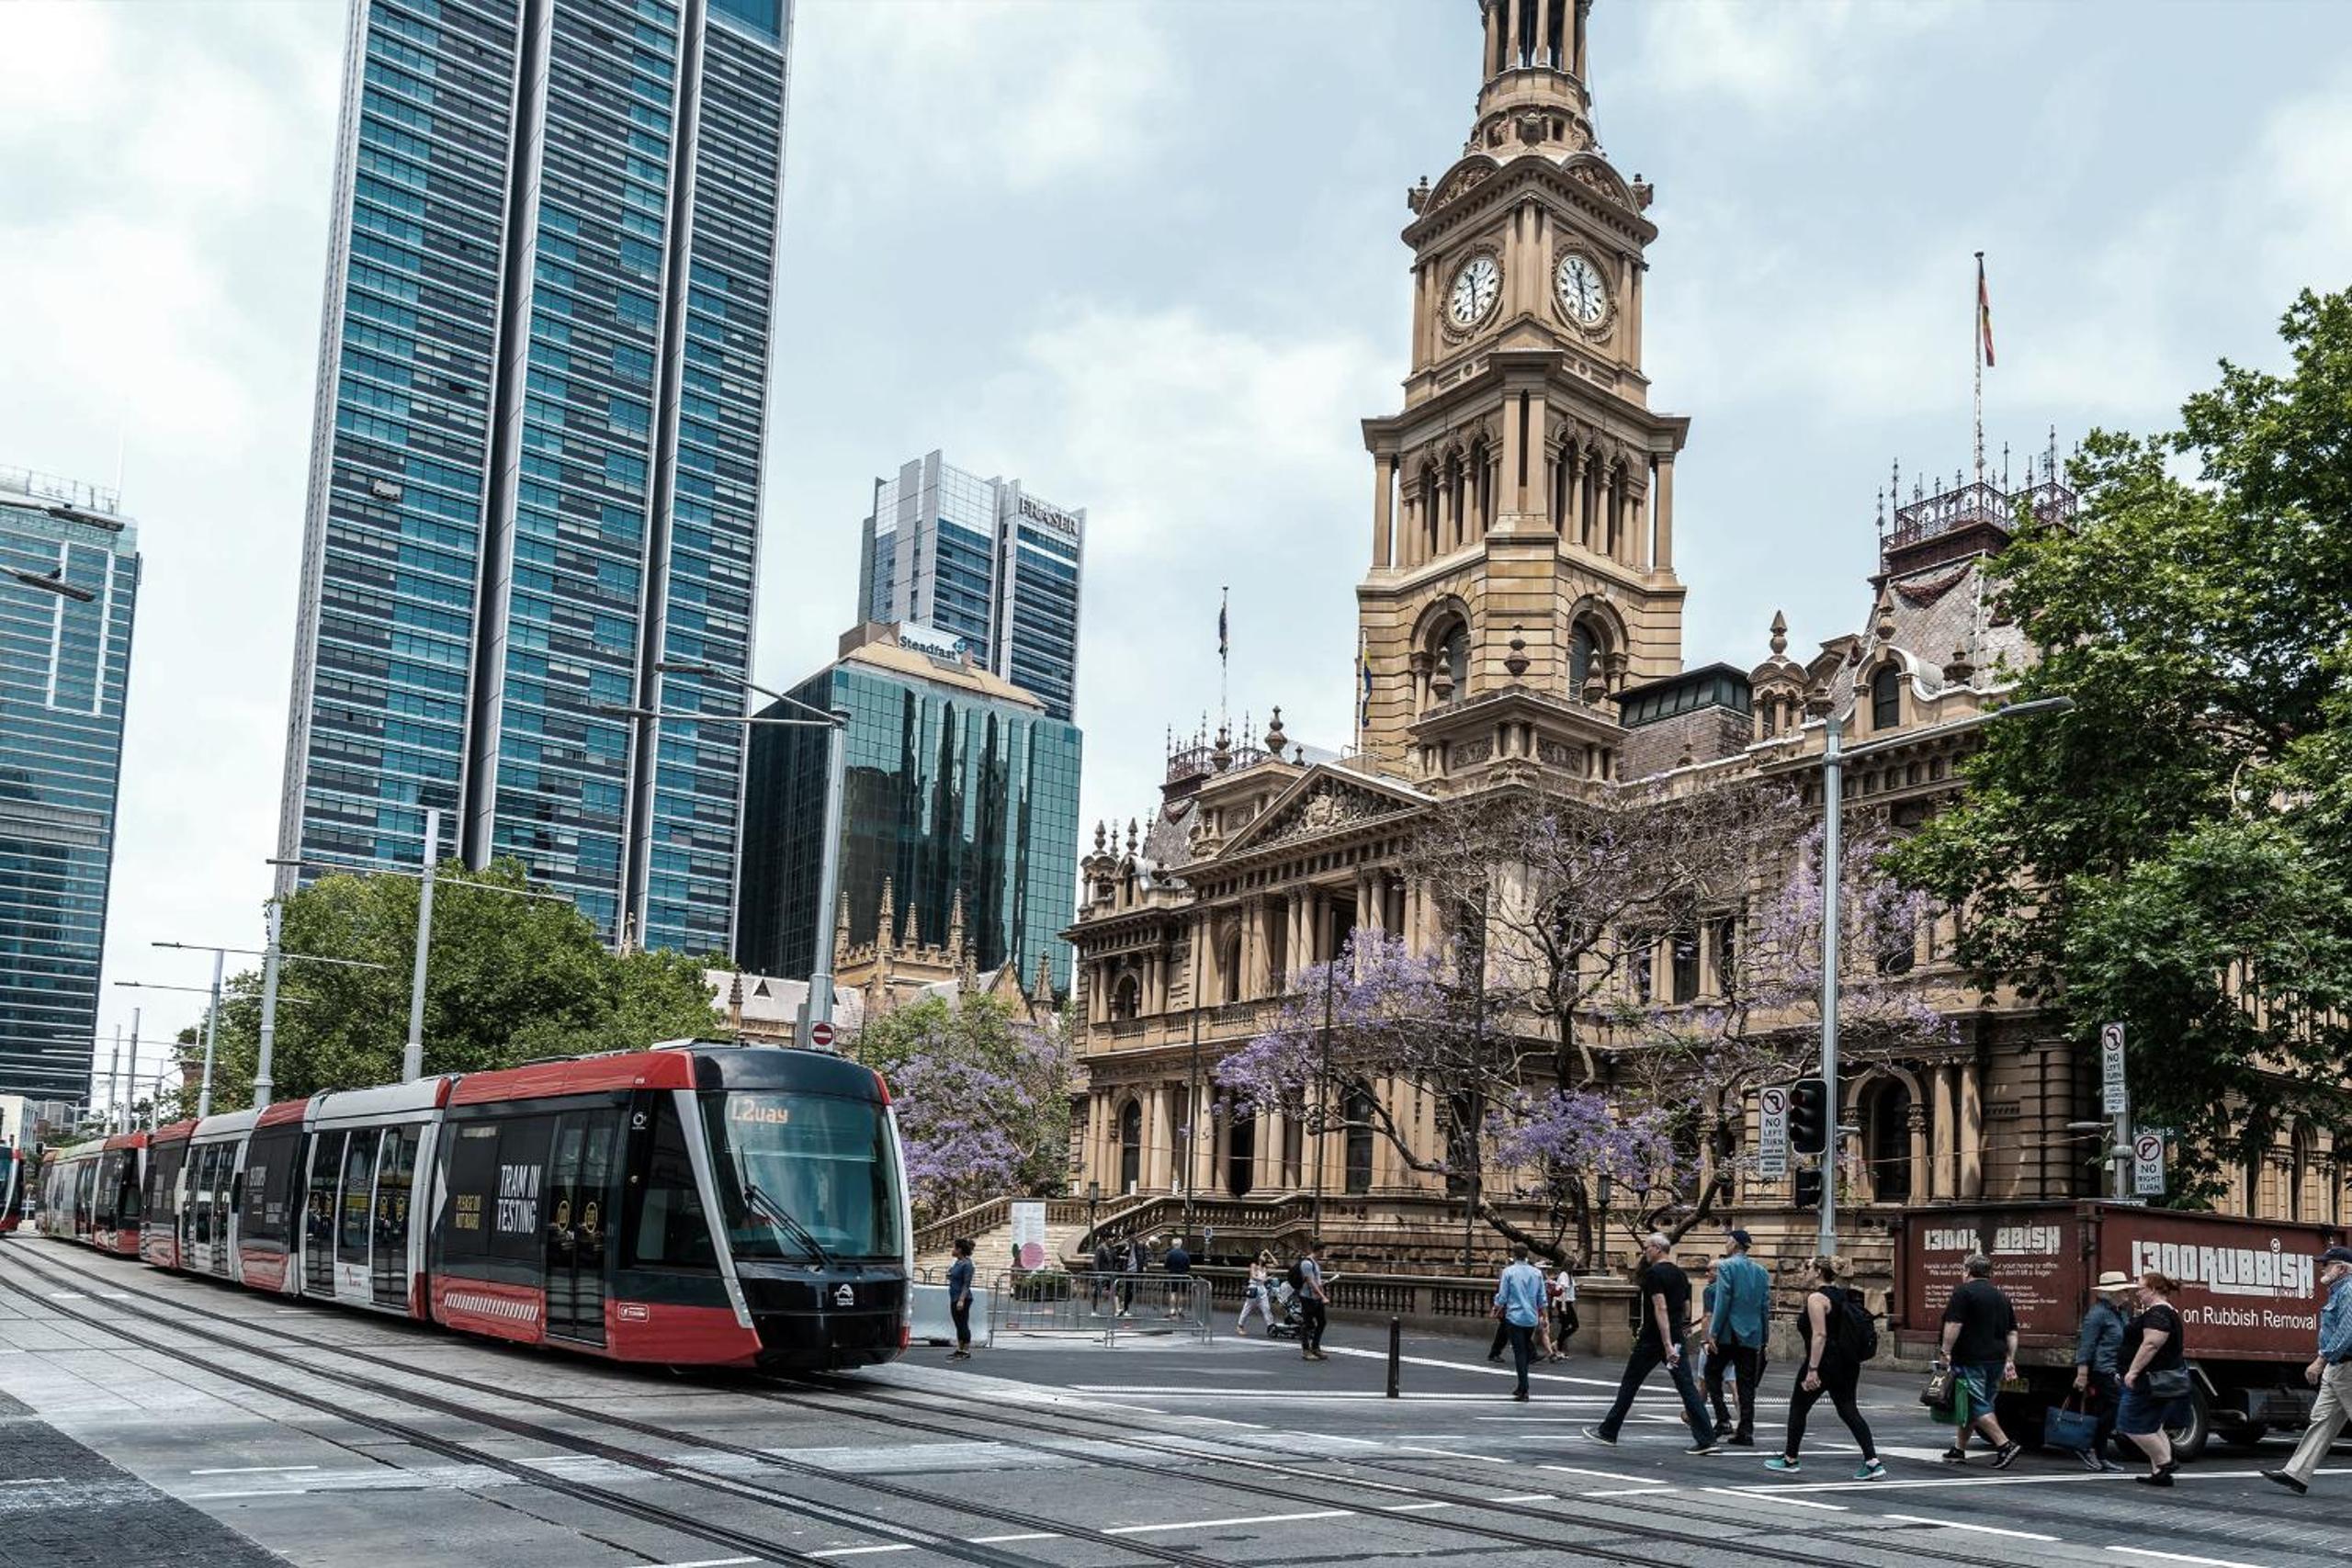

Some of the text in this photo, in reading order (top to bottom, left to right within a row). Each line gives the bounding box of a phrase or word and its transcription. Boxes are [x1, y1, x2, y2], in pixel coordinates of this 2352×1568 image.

[1019, 497, 1079, 536] FRASER
[899, 635, 956, 661] Steadfast
[2107, 1054, 2120, 1063] NO
[1765, 1118, 1781, 1128] NO
[1763, 1129, 1782, 1137] LEFT
[1763, 1137, 1783, 1145] TURN
[2140, 1164, 2157, 1174] NO
[500, 1164, 542, 1199] TRAM IN
[2138, 1175, 2161, 1183] RIGHT
[2139, 1183, 2160, 1191] TURN
[496, 1199, 537, 1234] TESTING
[2183, 1308, 2200, 1323] on
[2203, 1306, 2259, 1326] Rubbish
[2263, 1310, 2318, 1330] Removal
